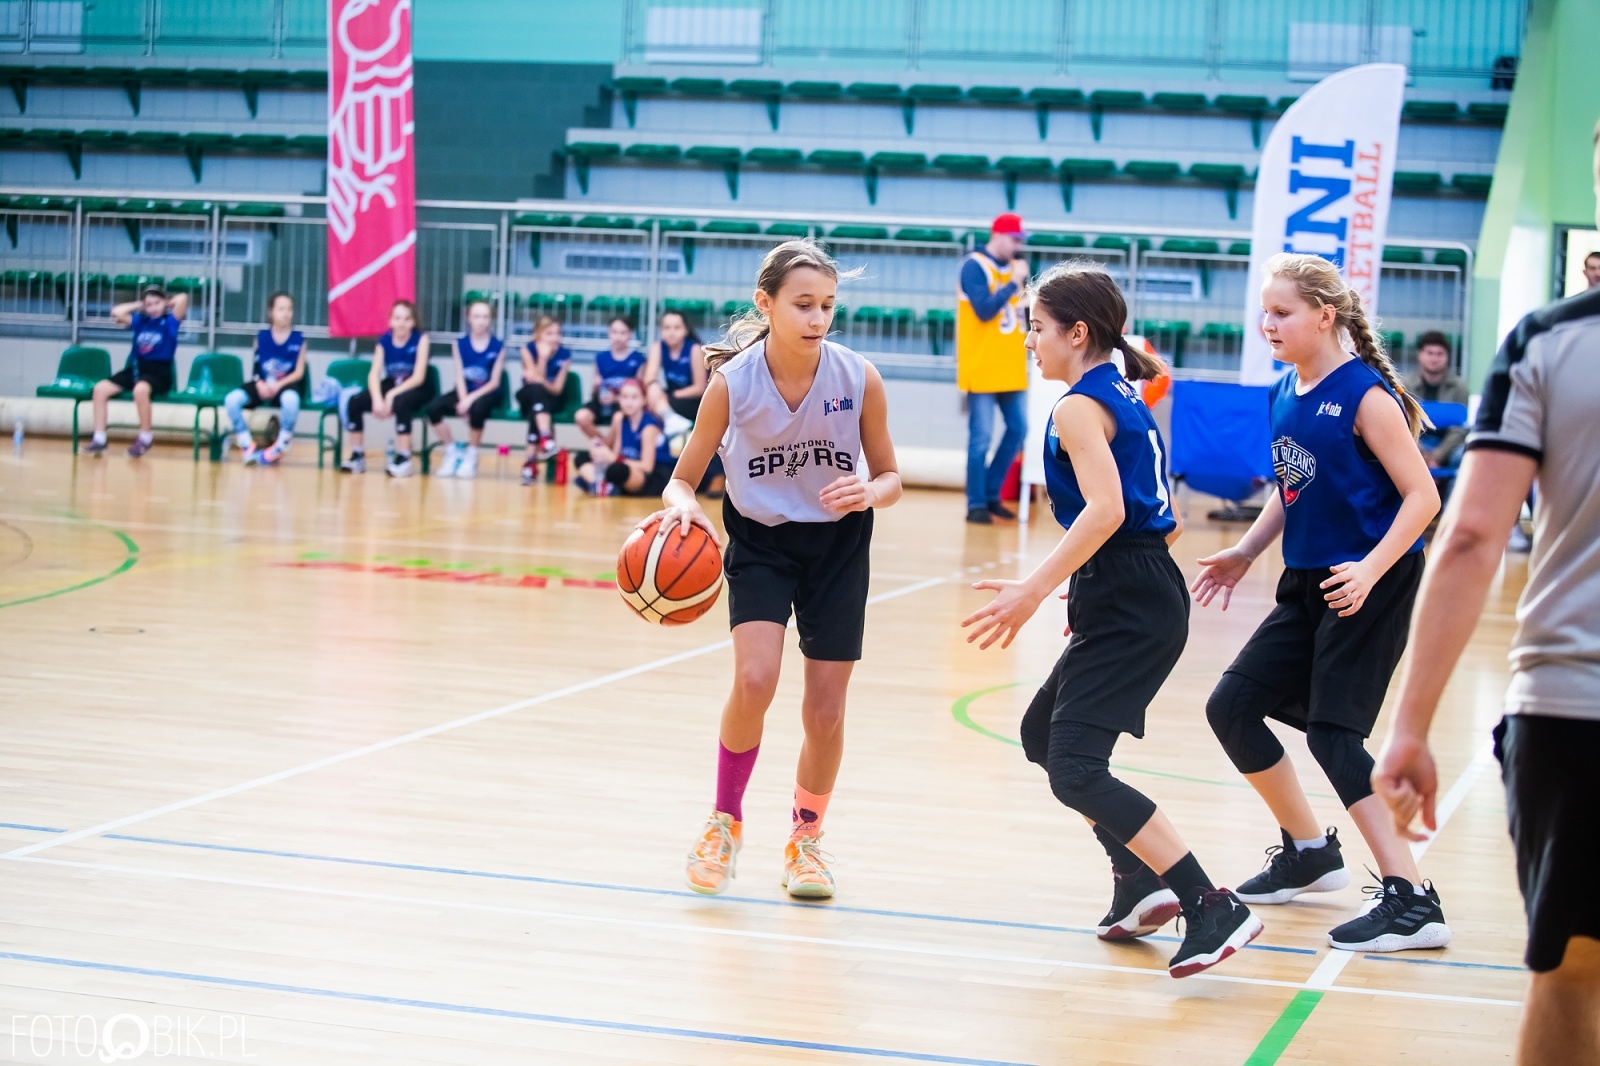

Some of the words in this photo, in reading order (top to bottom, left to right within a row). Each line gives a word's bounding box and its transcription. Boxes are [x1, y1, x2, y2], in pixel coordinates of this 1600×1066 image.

[763, 444, 785, 453] SAN
[786, 439, 835, 452] ANTONIO
[748, 447, 854, 480] SPURS
